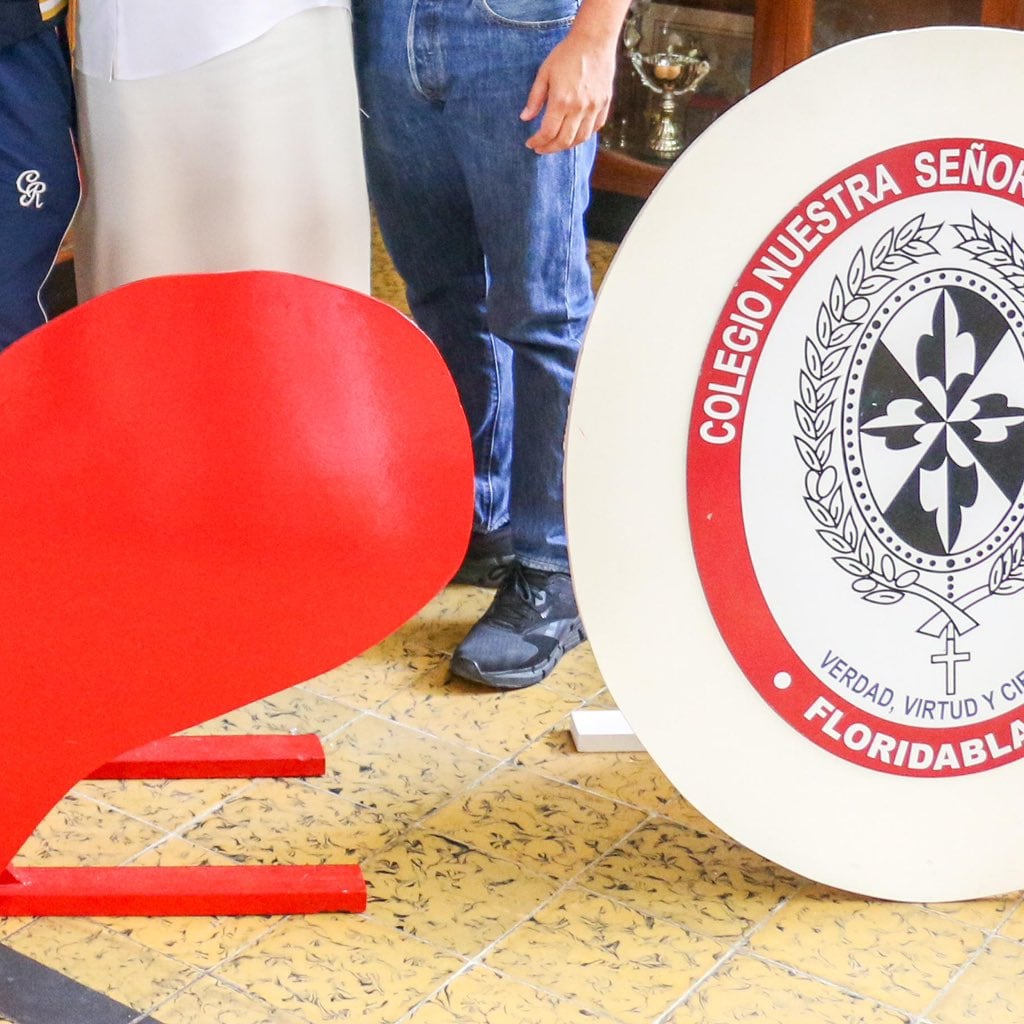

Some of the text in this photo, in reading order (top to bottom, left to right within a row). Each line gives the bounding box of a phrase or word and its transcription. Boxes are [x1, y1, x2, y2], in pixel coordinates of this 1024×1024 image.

[699, 290, 773, 445] COLEGIO
[752, 164, 902, 292] NUESTRA
[819, 649, 895, 714] VERDAD,
[904, 695, 978, 720] VIRTUD
[981, 690, 995, 711] Y
